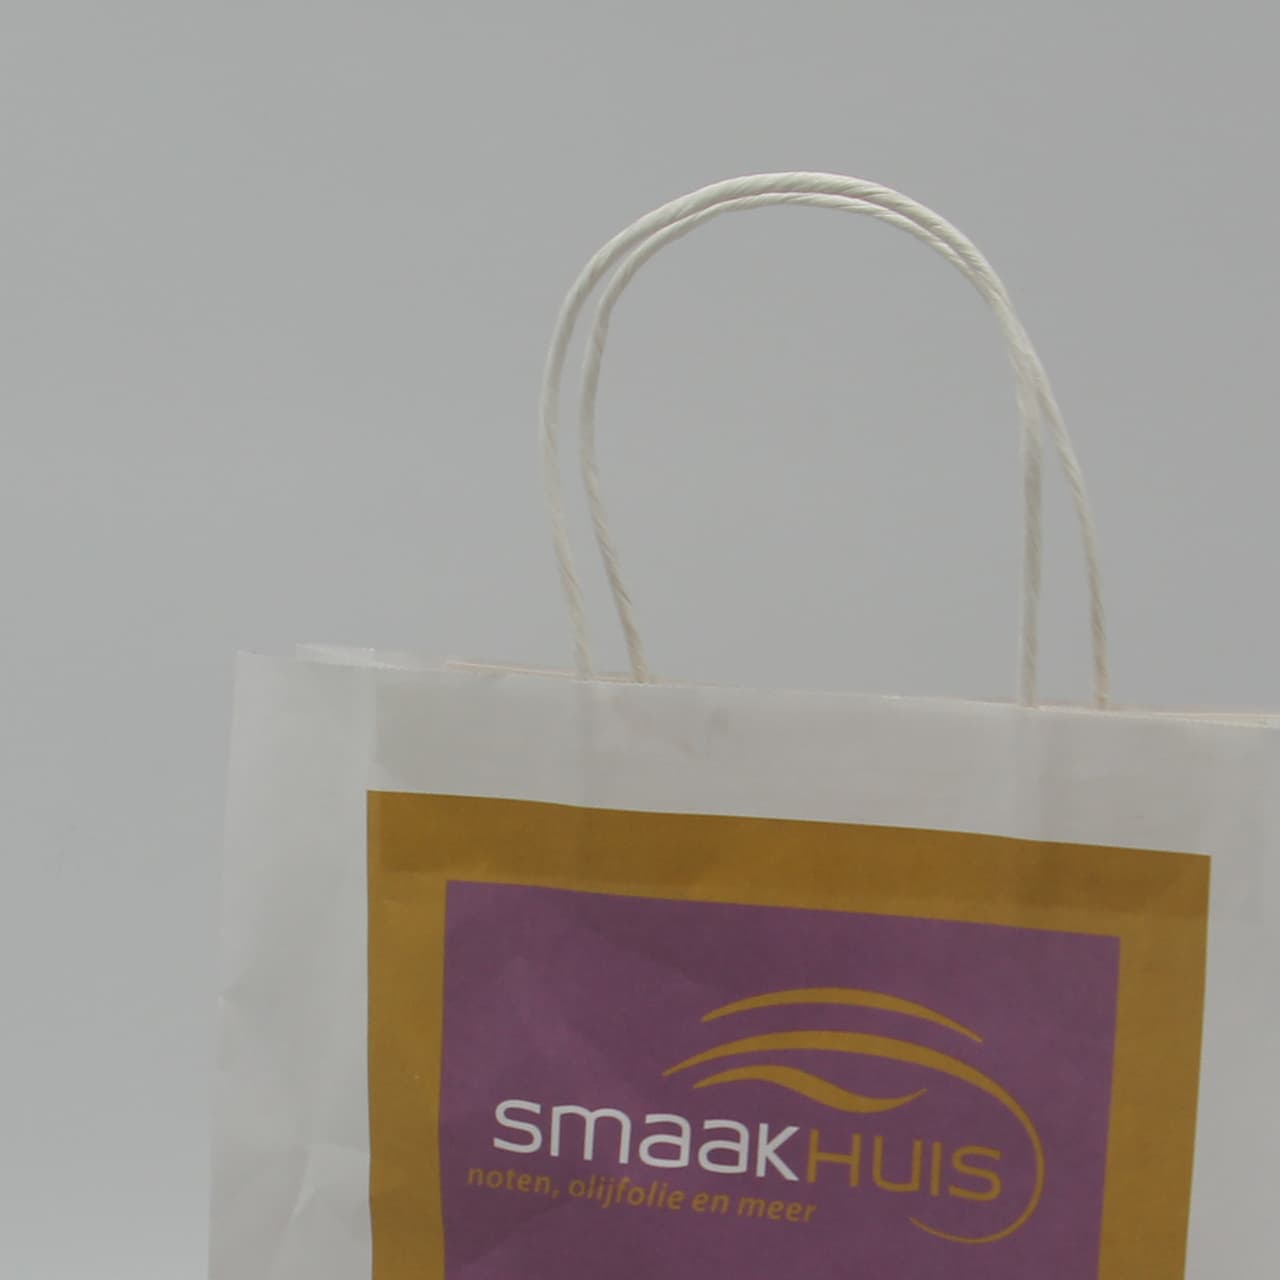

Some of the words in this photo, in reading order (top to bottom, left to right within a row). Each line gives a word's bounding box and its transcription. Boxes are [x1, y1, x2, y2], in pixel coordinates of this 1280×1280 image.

[467, 1167, 561, 1198] noten,
[569, 1174, 686, 1211] olijfolie
[691, 1190, 729, 1216] en
[736, 1196, 817, 1223] meer
